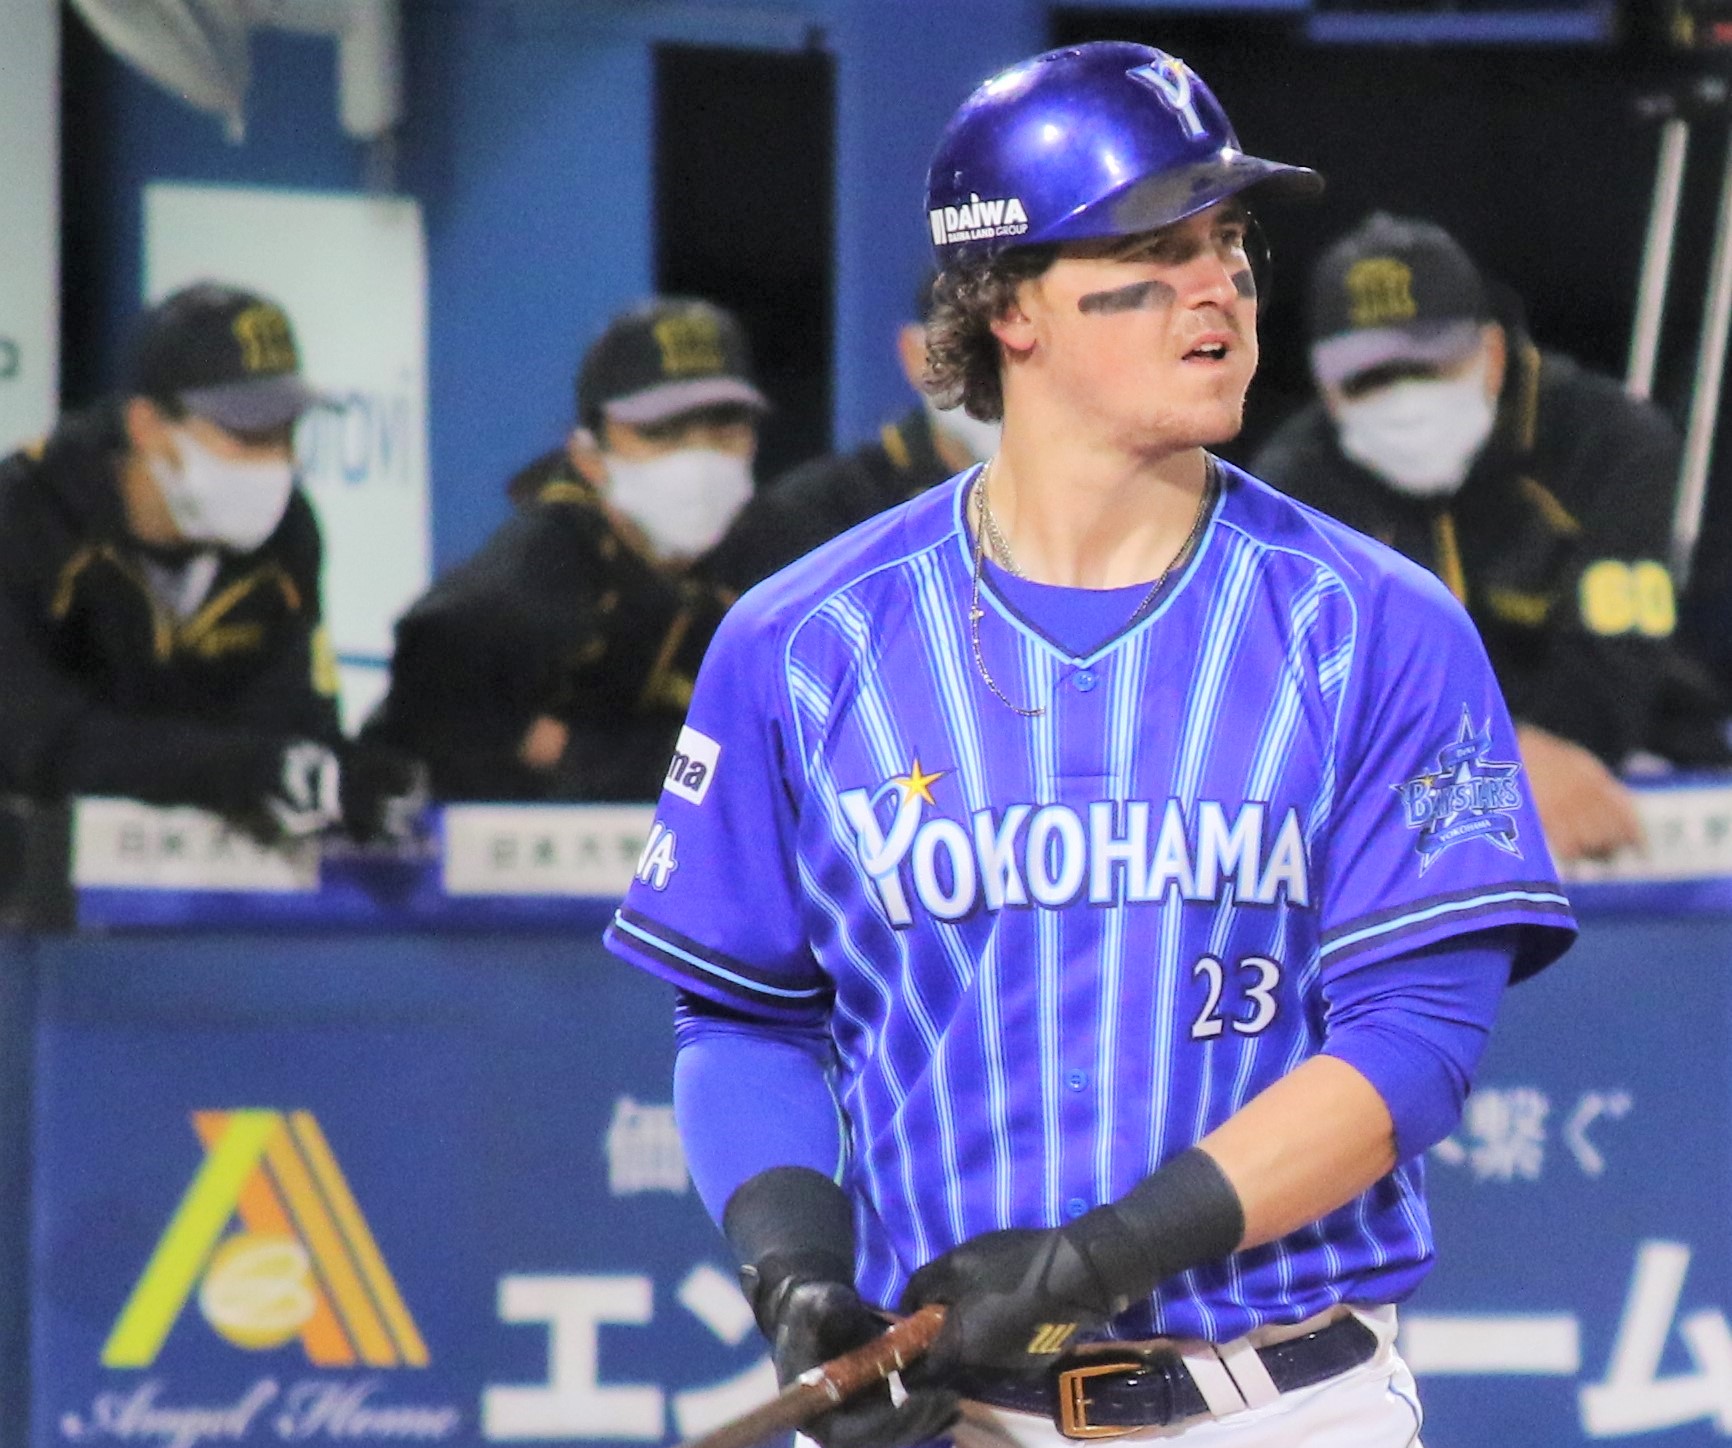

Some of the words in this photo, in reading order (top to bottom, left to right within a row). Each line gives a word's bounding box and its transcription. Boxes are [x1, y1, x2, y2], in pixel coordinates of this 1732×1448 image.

[1126, 58, 1208, 140] Y
[971, 228, 995, 240] LAND
[995, 223, 1029, 237] GROUP
[838, 770, 1310, 930] YOKOHAMA
[1440, 820, 1492, 842] YOKOHAMA
[1191, 956, 1281, 1040] 23
